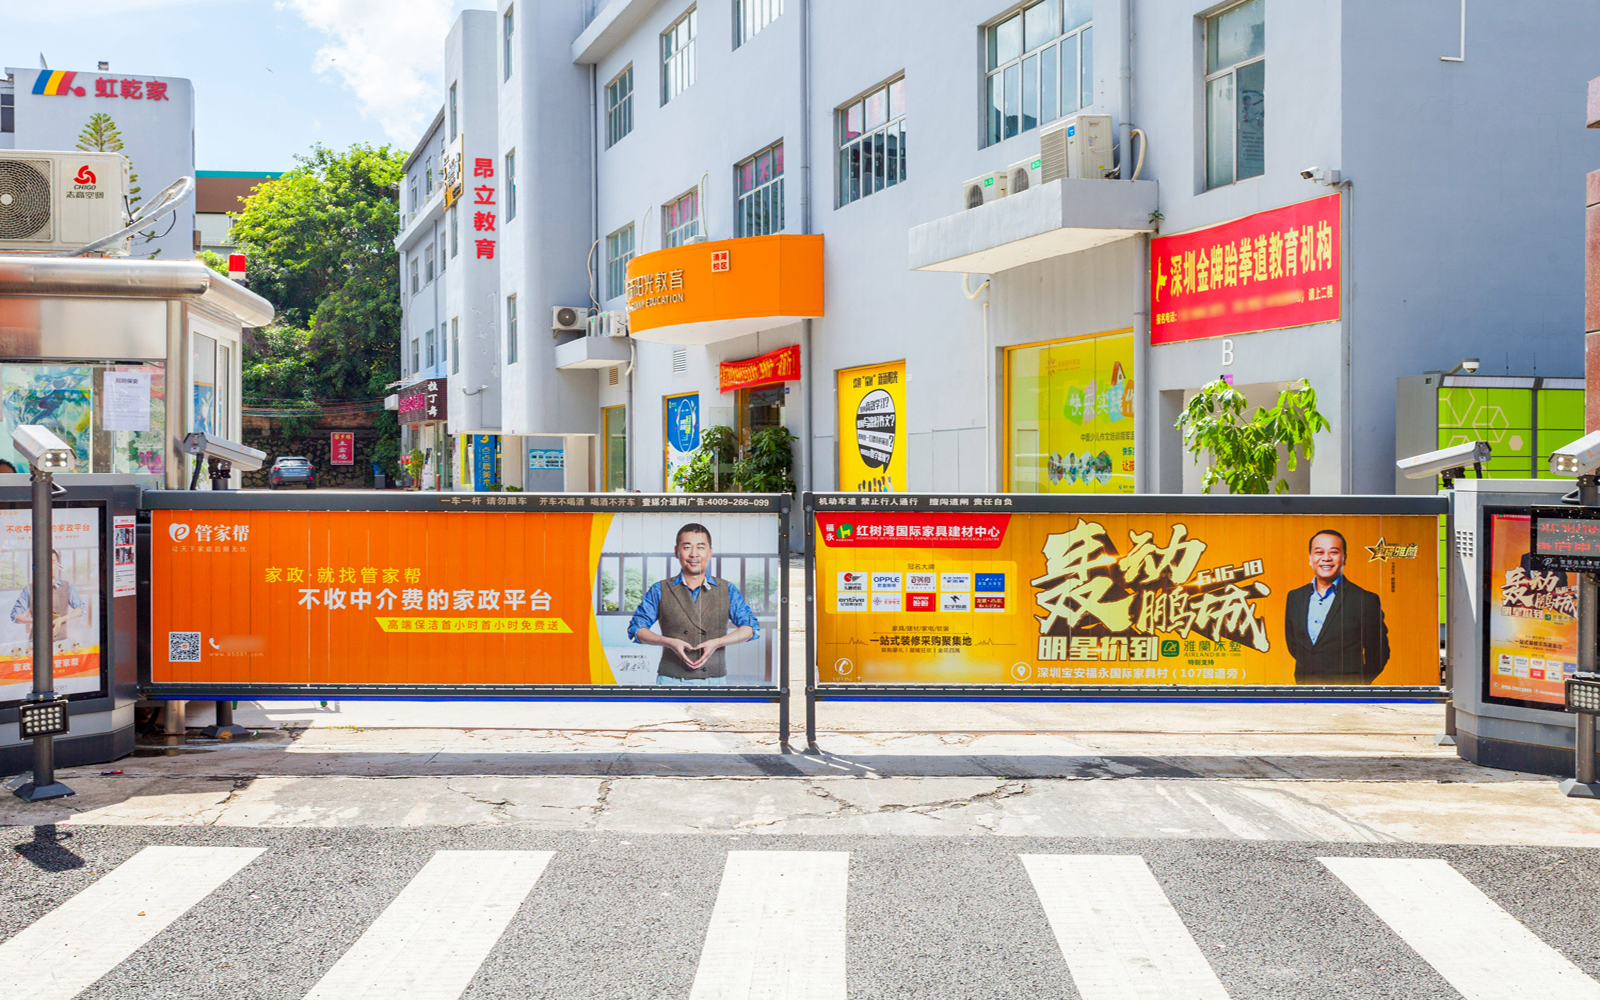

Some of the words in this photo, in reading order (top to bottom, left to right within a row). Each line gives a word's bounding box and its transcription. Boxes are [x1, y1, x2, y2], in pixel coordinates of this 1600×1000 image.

[94, 76, 169, 101] 虹乾家
[473, 157, 497, 260] 昂立教育
[1169, 218, 1333, 298] 深圳金牌跆拳道教育机构
[646, 293, 685, 307] EDUCATION
[1221, 338, 1235, 366] B
[441, 496, 482, 506] 一车一杆
[486, 496, 528, 506] 请勿跟车
[538, 497, 585, 507] 开车不喝酒
[590, 497, 636, 507] 喝酒不开车
[818, 497, 857, 506] 机动车道
[861, 497, 919, 506] 禁止行人通行
[929, 497, 970, 506] 擅闯道闸
[973, 497, 1013, 506] 责任自负
[194, 524, 250, 543] 管家帮
[825, 523, 835, 541] 福永
[856, 525, 1000, 537] 红树湾国际家具建材中心
[264, 566, 422, 584] 家政·就找管家帮
[1197, 558, 1264, 587] 6.16-18
[298, 588, 553, 611] 不收中介费的家政平台
[386, 619, 560, 631] 高端保洁首小时首小时免费送
[870, 635, 973, 646] 一站式装修采购聚集地
[1037, 636, 1160, 661] 明星价到
[1183, 640, 1242, 653] 雅蘭床墊
